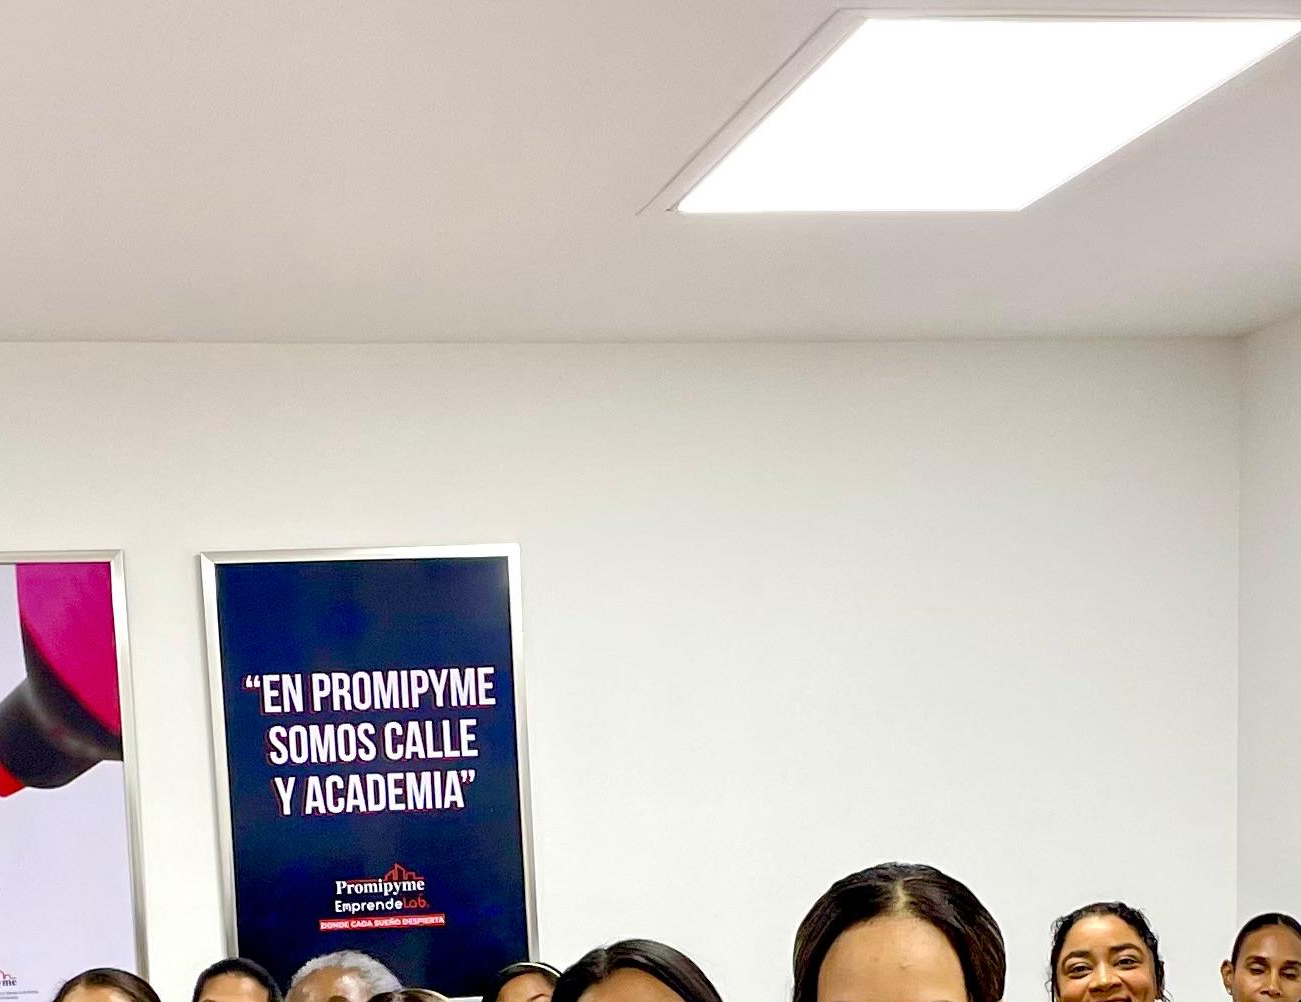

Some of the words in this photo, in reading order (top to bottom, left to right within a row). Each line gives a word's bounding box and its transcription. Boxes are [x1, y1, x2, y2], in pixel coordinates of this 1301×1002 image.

[312, 667, 496, 711] PROMIPYME
[268, 722, 377, 765] SOMOS
[384, 719, 479, 760] CALLE
[274, 776, 295, 815] Y
[335, 878, 425, 896] Promipyme
